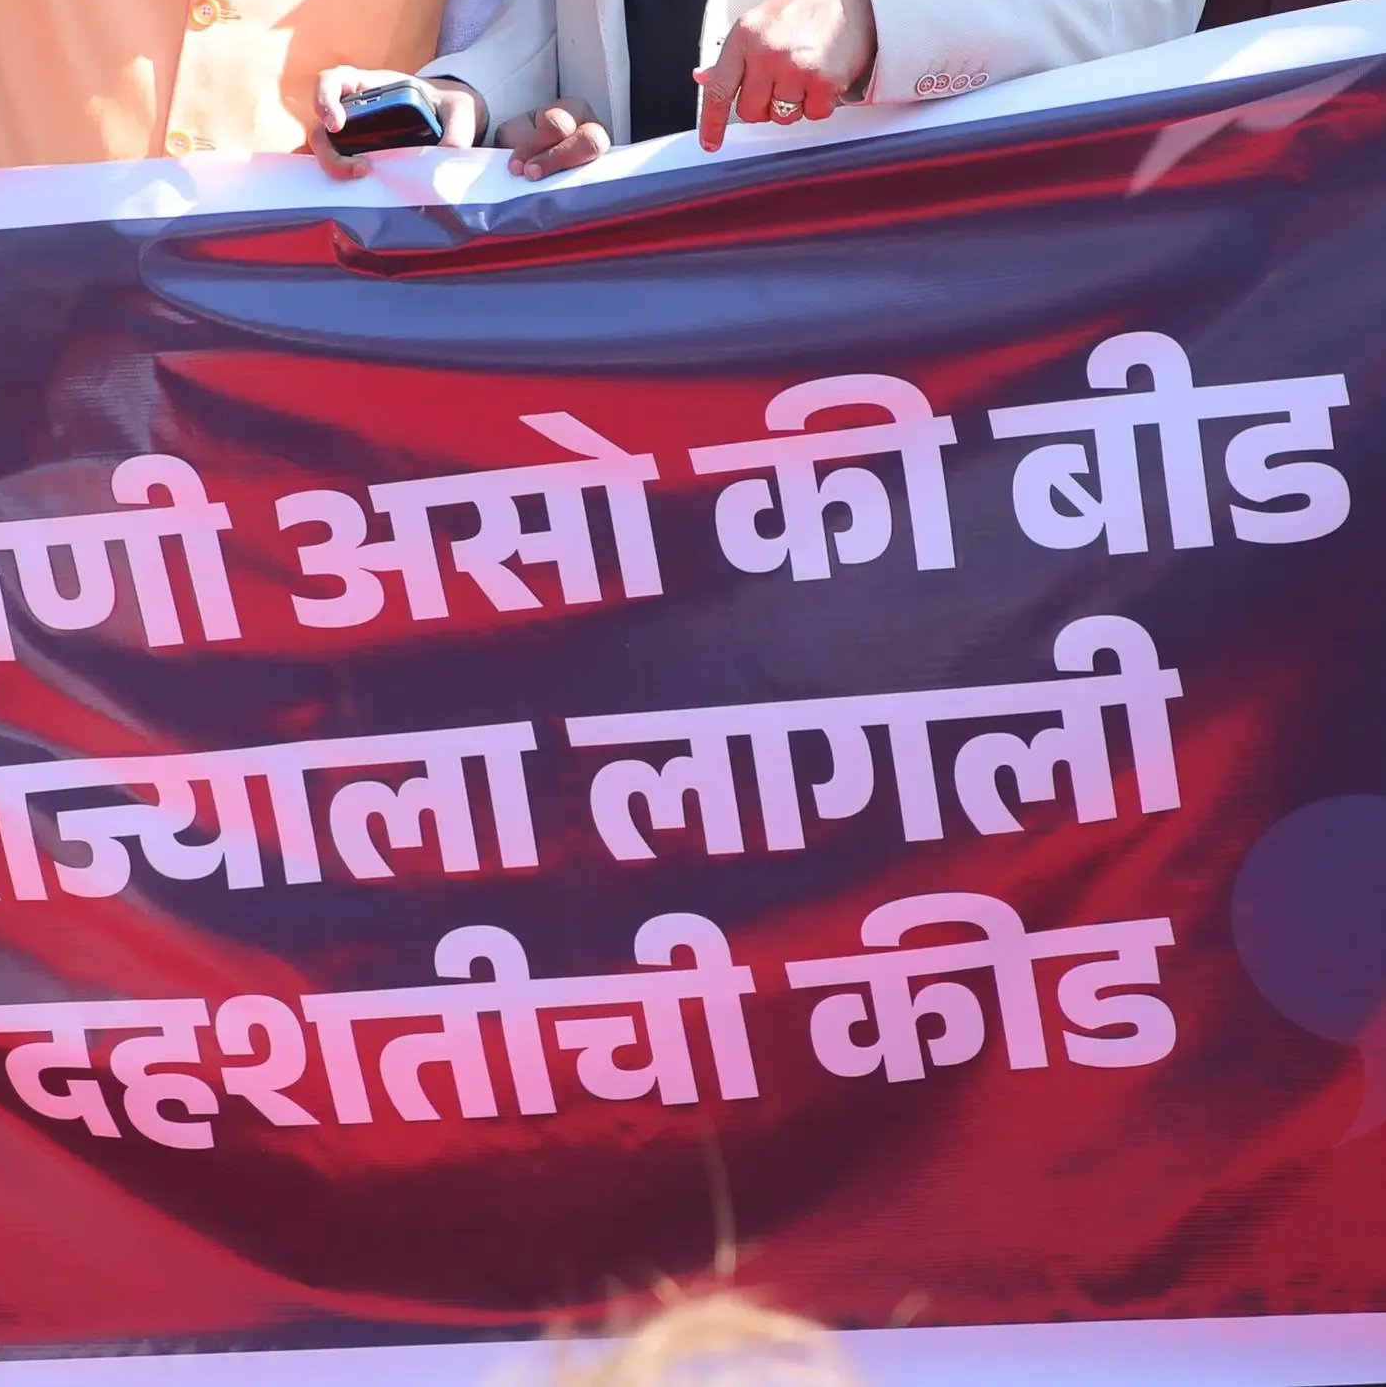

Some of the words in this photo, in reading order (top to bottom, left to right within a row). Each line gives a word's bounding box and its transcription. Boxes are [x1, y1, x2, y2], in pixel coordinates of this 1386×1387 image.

[275, 411, 663, 630] असो
[689, 373, 959, 582] की
[988, 330, 1353, 559] बीड
[566, 615, 1182, 863] लागली
[786, 892, 1177, 1084] कीड
